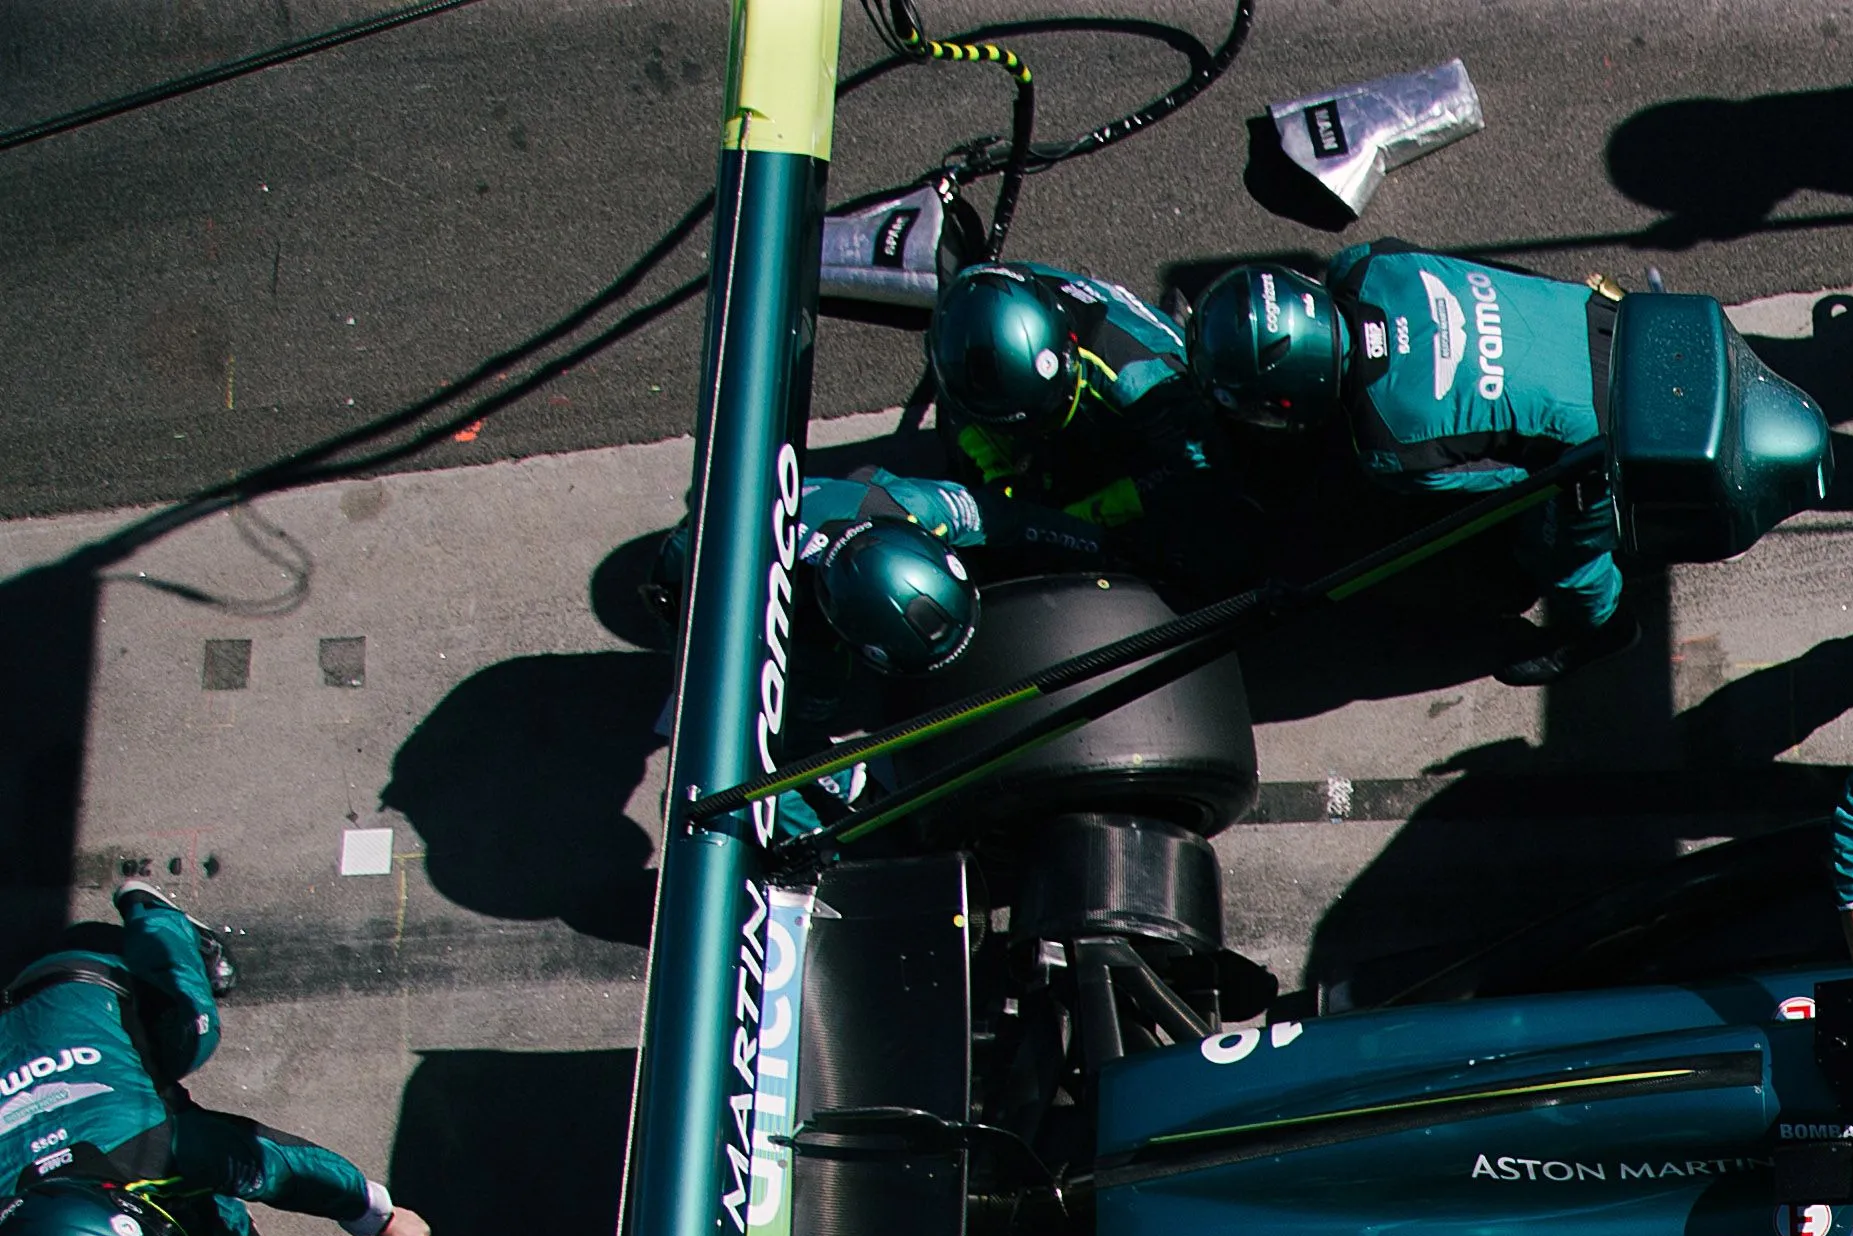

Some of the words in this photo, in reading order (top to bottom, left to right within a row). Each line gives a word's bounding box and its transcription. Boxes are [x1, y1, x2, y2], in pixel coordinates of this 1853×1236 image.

[1477, 271, 1503, 402] aramco
[752, 441, 800, 848] aramco
[721, 879, 772, 1234] MARTIN
[1471, 1153, 1607, 1181] ASTON
[1619, 1155, 1776, 1180] MARTIN
